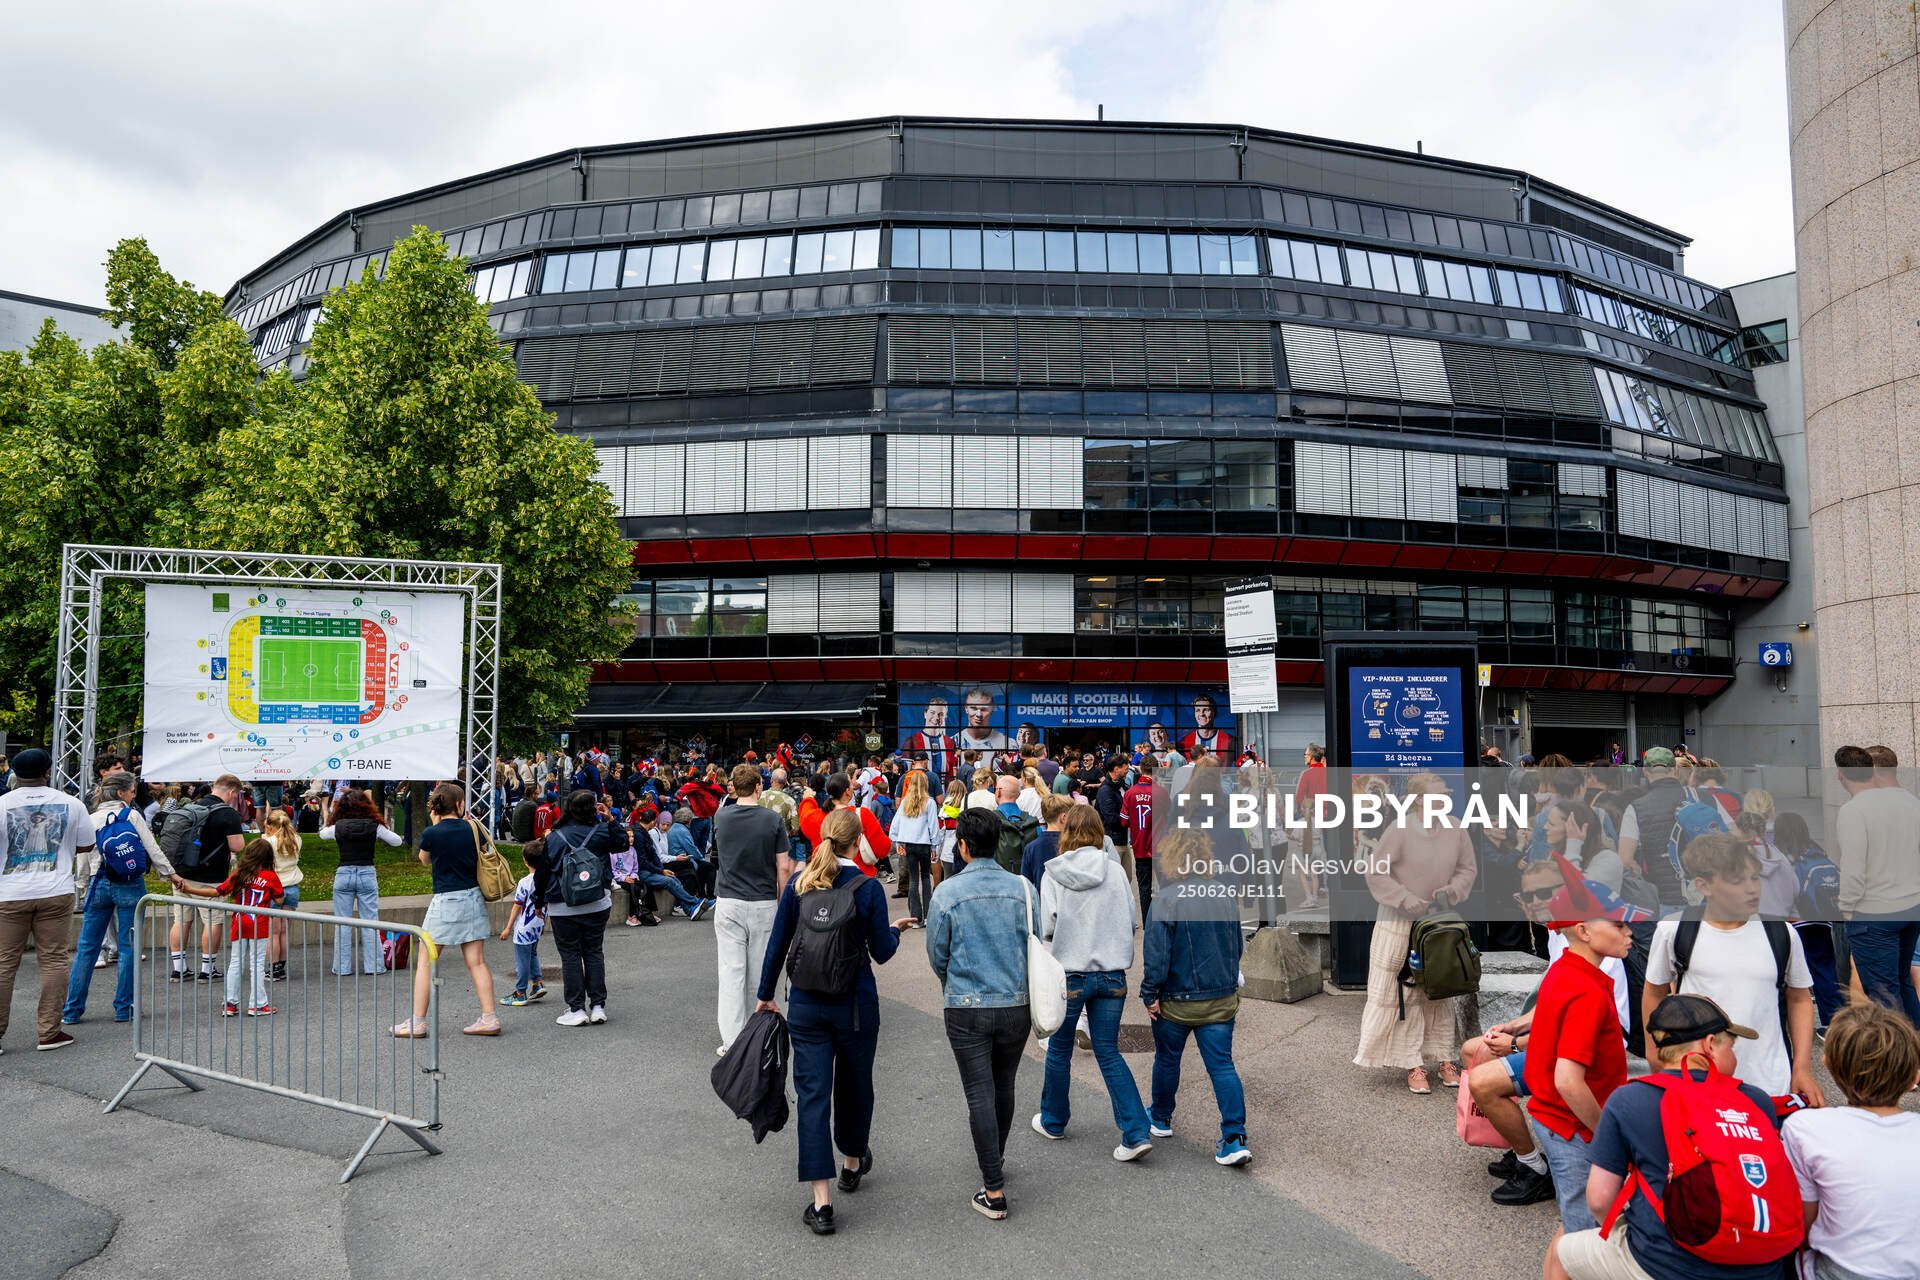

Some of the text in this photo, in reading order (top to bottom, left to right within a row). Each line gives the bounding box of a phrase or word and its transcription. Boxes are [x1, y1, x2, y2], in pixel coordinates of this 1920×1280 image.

[1245, 582, 1269, 590] parkering
[389, 654, 399, 687] VG
[1031, 693, 1143, 704] MAKE FOOTBALL
[1016, 705, 1157, 716] DREAMS COME TRUE
[866, 736, 880, 744] OPEN
[347, 759, 392, 770] T-BANE
[1136, 804, 1151, 830] 17
[115, 846, 135, 858] TINE
[1715, 1121, 1763, 1142] TINE
